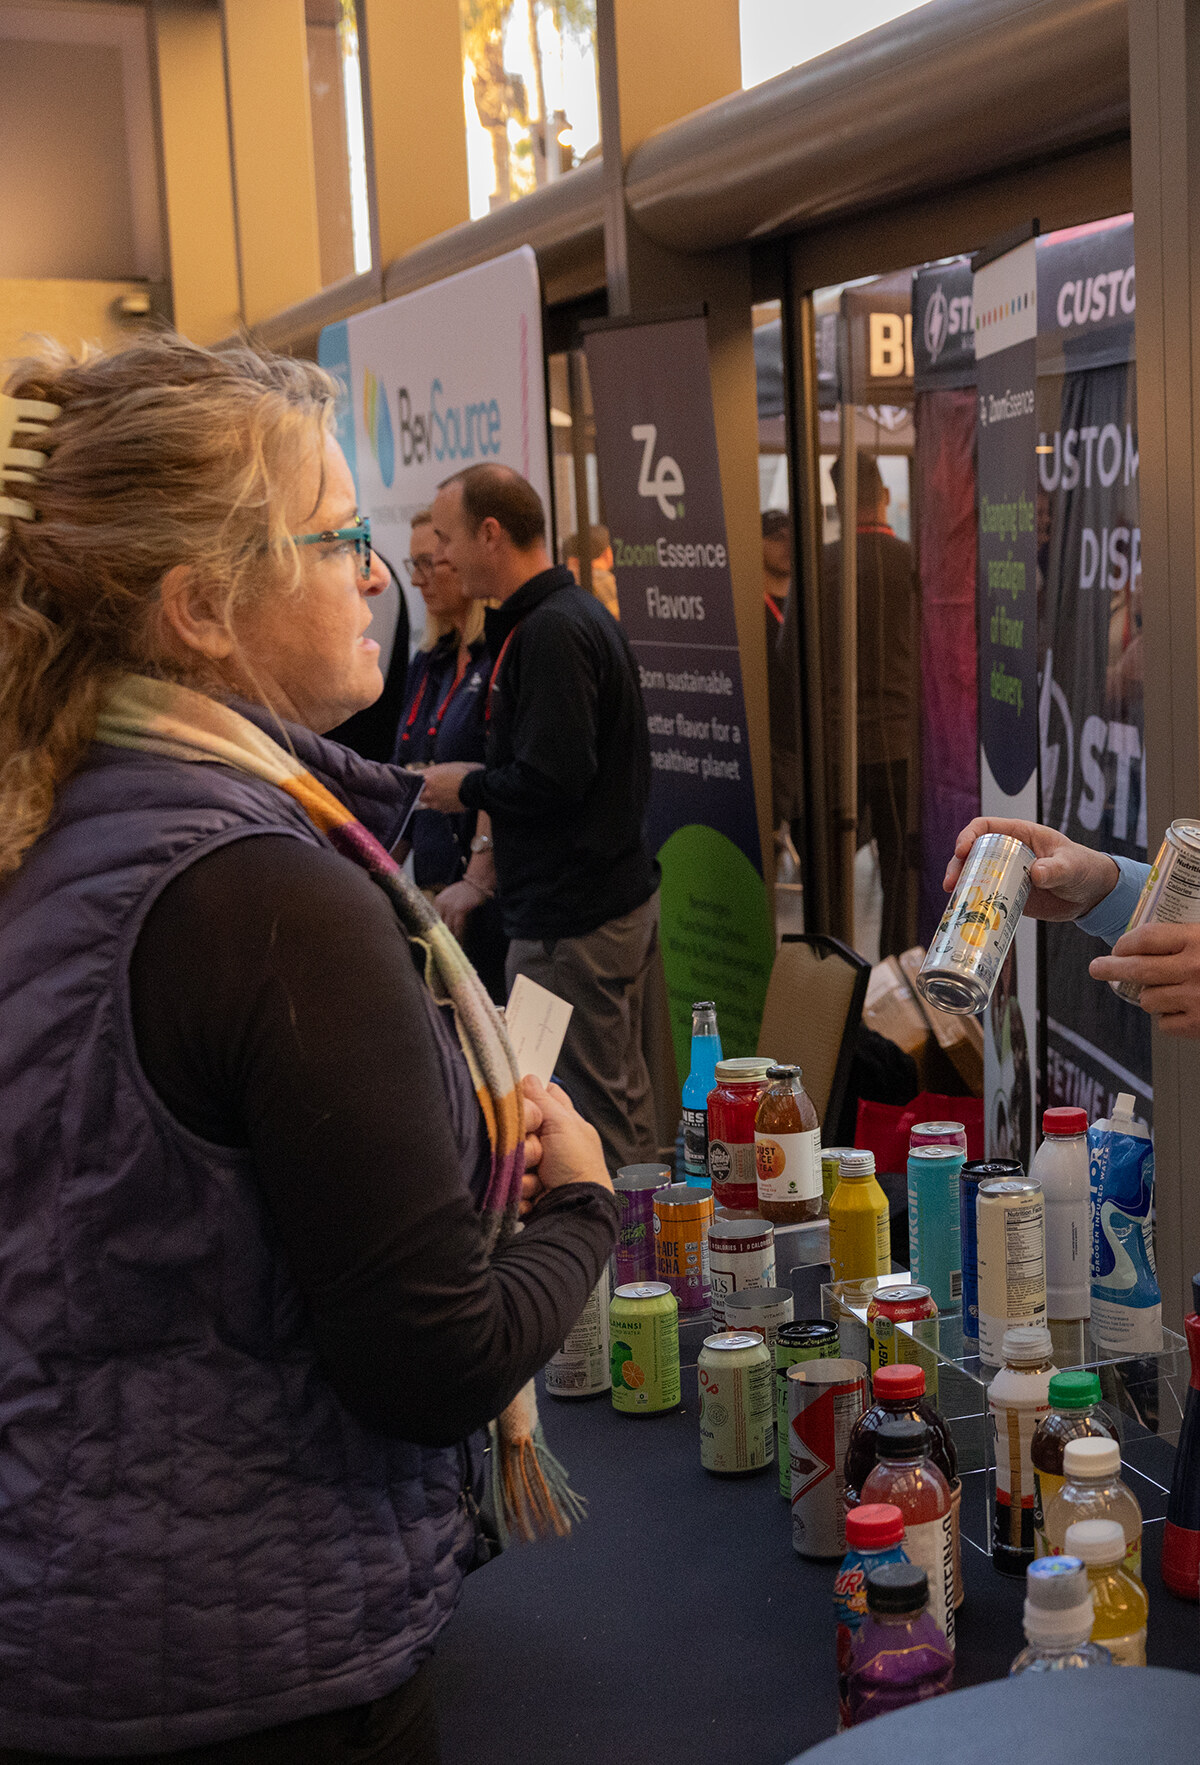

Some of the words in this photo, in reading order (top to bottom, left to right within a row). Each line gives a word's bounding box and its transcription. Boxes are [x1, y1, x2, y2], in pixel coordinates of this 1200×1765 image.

[398, 378, 501, 467] BevSource
[614, 537, 727, 569] ZoomEssence
[646, 586, 705, 621] Flavors
[646, 713, 675, 736] etter
[732, 725, 741, 744] a
[1167, 880, 1192, 896] Calories
[1095, 1184, 1104, 1227] INFUSED
[1100, 1147, 1111, 1180] WATER
